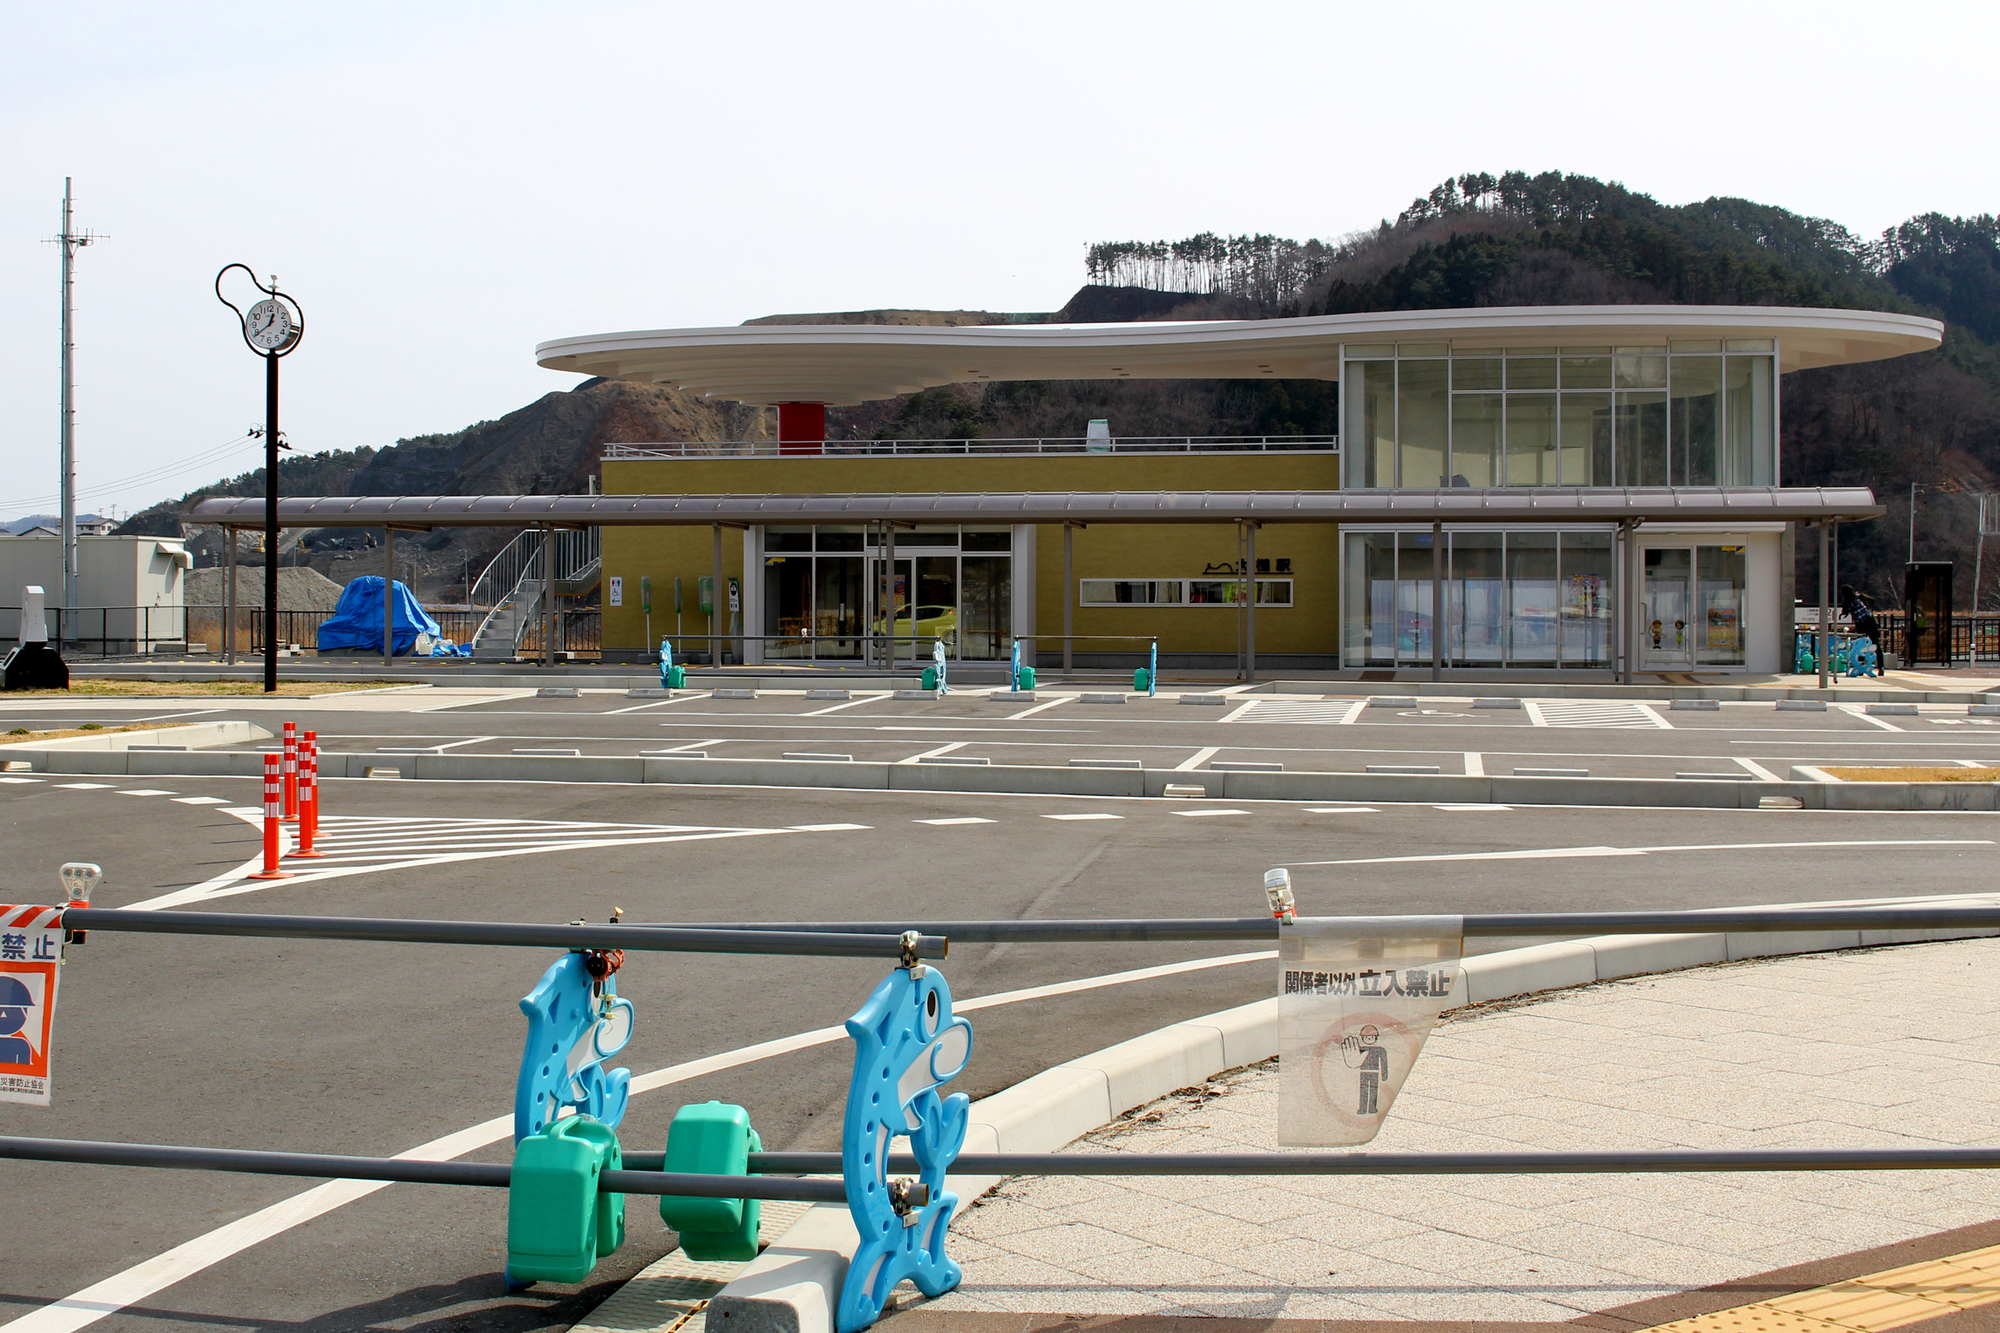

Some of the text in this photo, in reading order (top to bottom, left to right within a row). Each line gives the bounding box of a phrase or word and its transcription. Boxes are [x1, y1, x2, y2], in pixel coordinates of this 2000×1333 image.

[260, 305, 266, 314] 11
[281, 312, 286, 320] 2
[252, 321, 257, 329] 9
[282, 320, 288, 328] 3
[260, 334, 265, 342] 7
[274, 334, 280, 342] 5
[1, 933, 56, 960] 禁止
[1285, 969, 1451, 997] 関係者以外立入禁止
